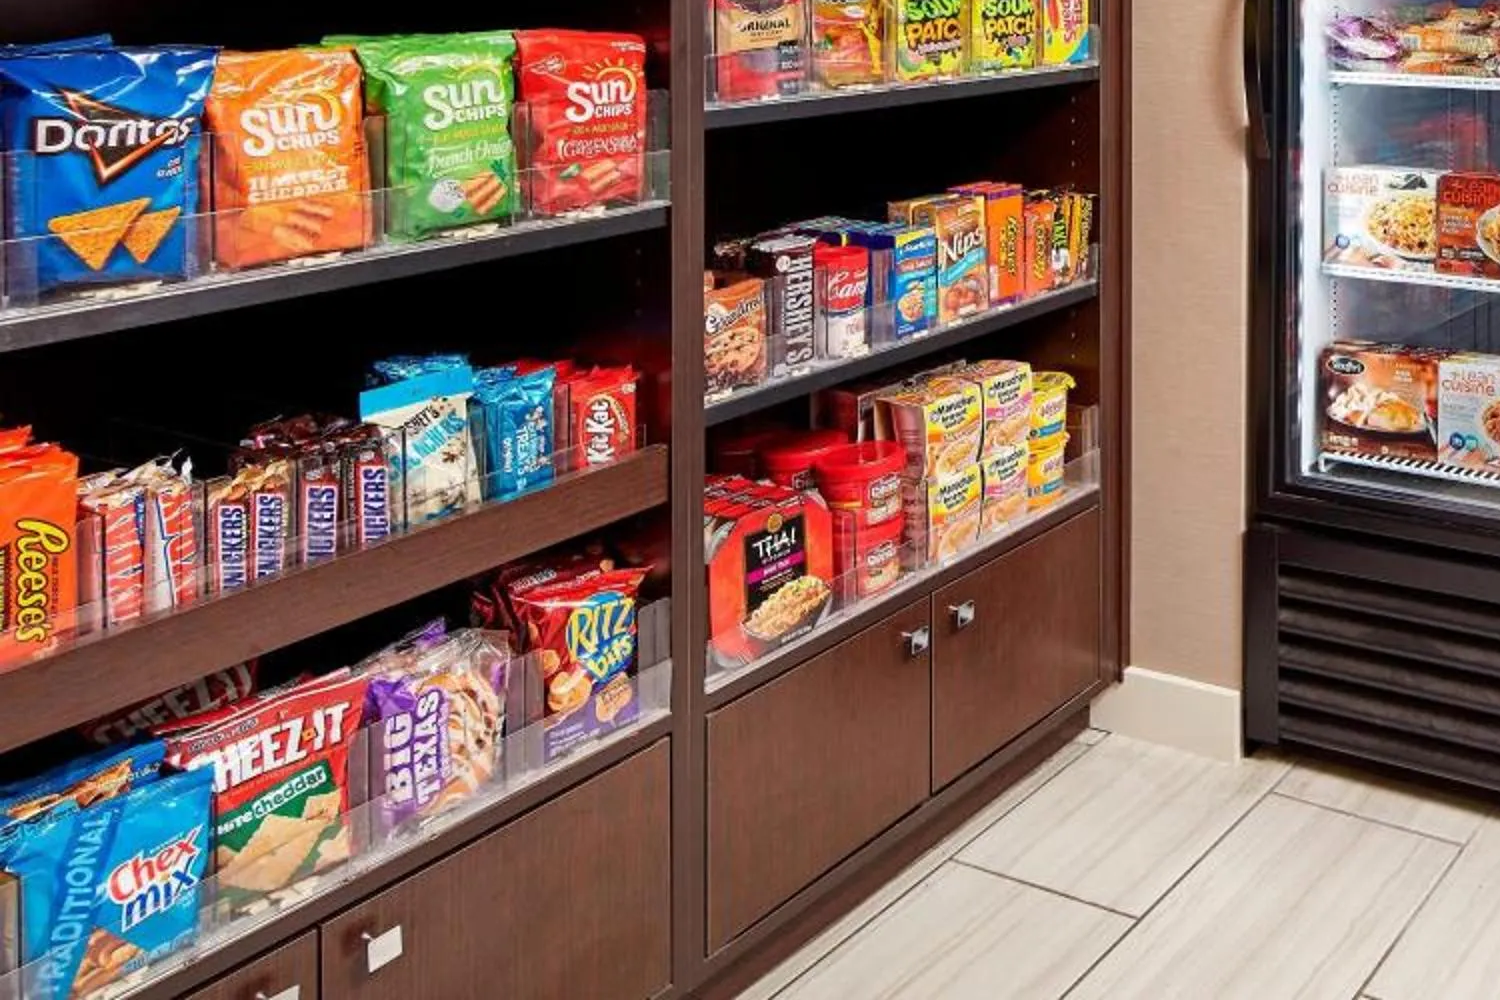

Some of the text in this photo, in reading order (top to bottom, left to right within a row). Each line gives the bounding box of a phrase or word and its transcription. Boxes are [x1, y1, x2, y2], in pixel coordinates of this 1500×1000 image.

[905, 18, 961, 50] PATC
[984, 16, 1036, 40] PATCH
[239, 89, 342, 158] Sun
[422, 77, 506, 131] Sun
[454, 103, 506, 121] CHIPS
[565, 76, 637, 123] Sun
[594, 103, 633, 117] CHIPS
[32, 115, 196, 155] Doritos
[275, 131, 342, 153] CHIPS
[940, 228, 985, 265] Nips
[786, 256, 814, 367] HERSHEY'S
[936, 394, 977, 414] Maruchan
[752, 527, 797, 558] THAI
[14, 518, 70, 643] Reese's
[567, 597, 637, 662] RITZ
[383, 711, 414, 808] BIG
[413, 689, 443, 806] TEXAS
[252, 764, 327, 820] cheddar
[108, 826, 201, 902] Chex
[122, 857, 201, 932] mix
